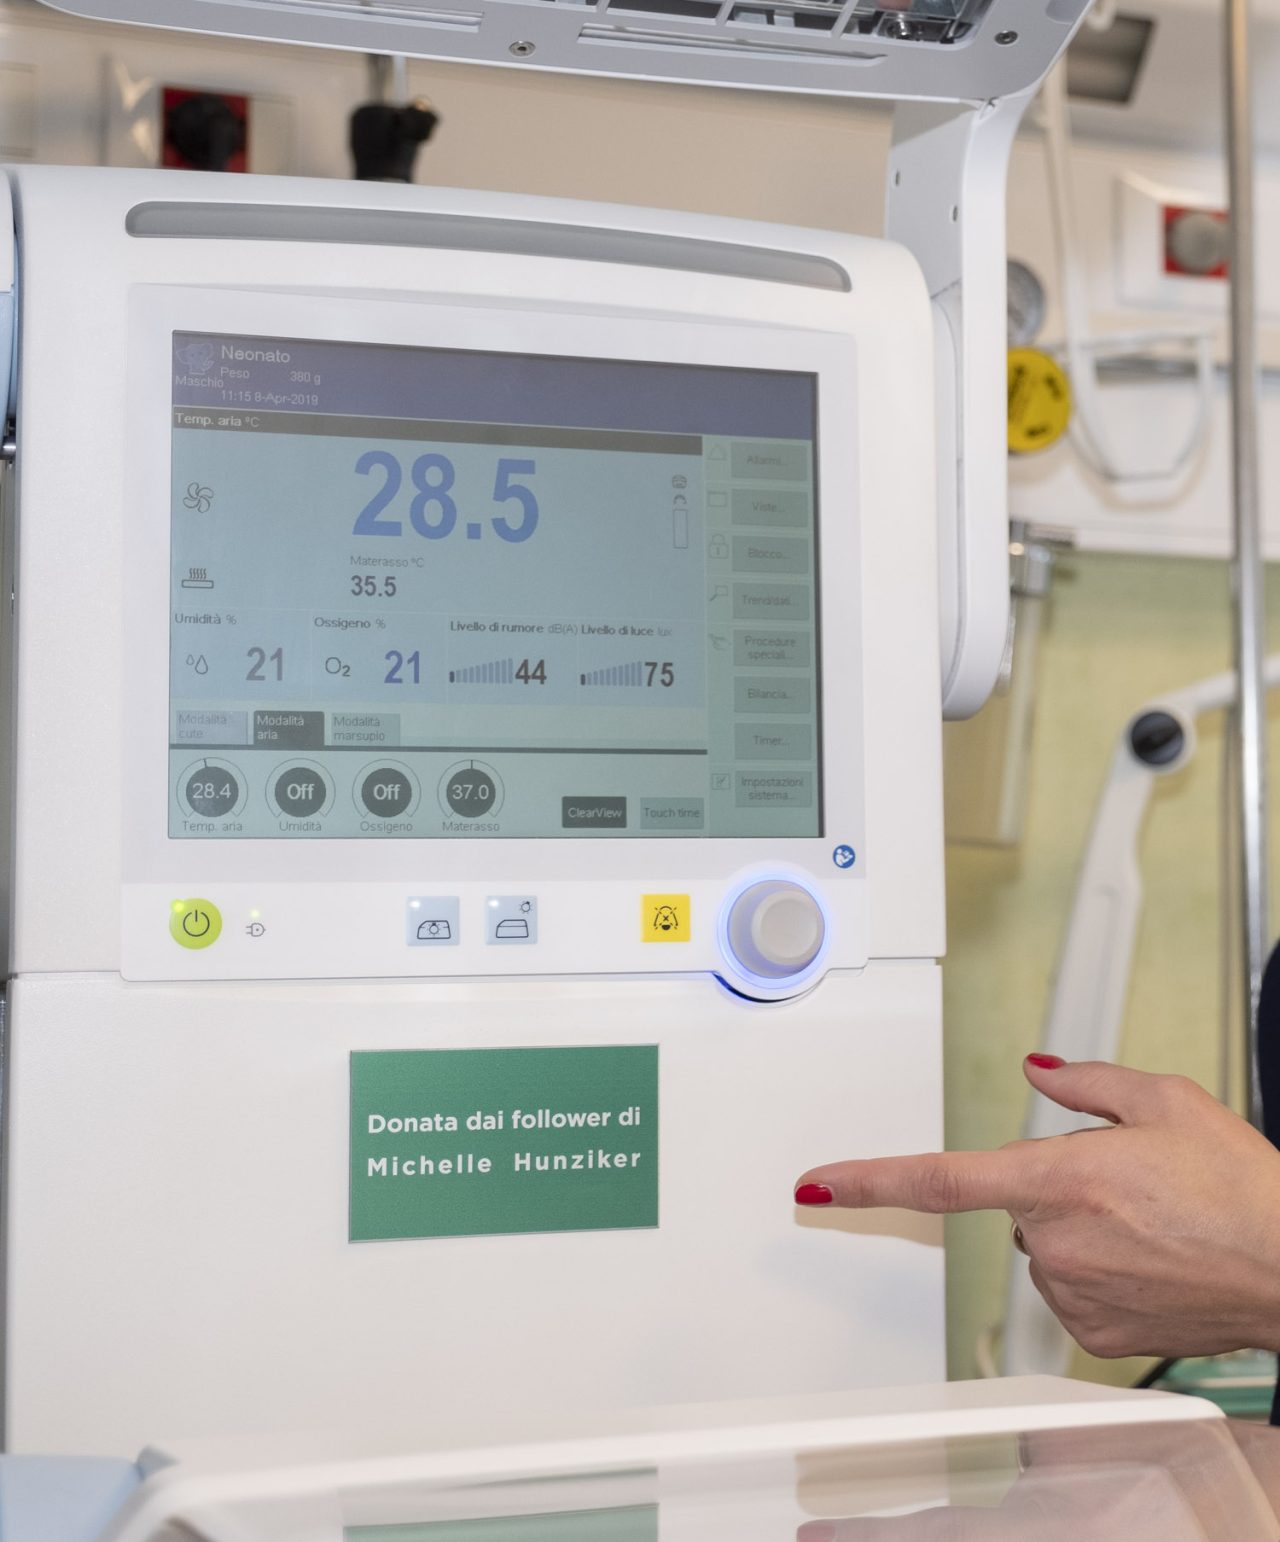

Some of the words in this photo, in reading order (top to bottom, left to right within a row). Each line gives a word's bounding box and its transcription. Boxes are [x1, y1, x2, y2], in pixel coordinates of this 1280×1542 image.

[221, 345, 290, 364] Neonato
[175, 376, 224, 389] Maschio
[220, 367, 250, 379] Peso
[313, 373, 321, 385] g
[221, 390, 251, 402] 11:15
[175, 412, 214, 426] Temp.
[218, 415, 241, 427] aria
[352, 451, 539, 543] 28.5
[350, 556, 408, 568] Materasso
[351, 575, 397, 598] 35.5
[175, 613, 221, 625] Umidità
[225, 615, 237, 625] %
[314, 617, 371, 631] Ossigeno
[375, 618, 386, 629] %
[450, 621, 486, 634] Livello
[489, 622, 499, 634] di
[501, 624, 544, 635] rumore
[547, 623, 579, 637] dB(A)
[581, 625, 615, 636] Livello
[618, 626, 628, 637] di
[631, 626, 654, 637] luce
[744, 636, 796, 646] Procedure
[246, 647, 283, 681] 21
[384, 650, 420, 684] 21
[514, 659, 547, 685] 44
[644, 662, 675, 687] 75
[257, 716, 305, 727] Modalità
[334, 716, 381, 727] Modalità
[257, 730, 278, 740] aria
[334, 731, 386, 743] marsupio
[741, 777, 804, 789] Impostazioni
[192, 783, 232, 799] 28.4
[287, 783, 315, 800] Off
[373, 784, 401, 800] Off
[452, 785, 490, 800] 37.0
[568, 807, 622, 819] ClearView
[644, 807, 674, 819] Touch
[677, 807, 700, 819] time
[182, 821, 217, 833] Temp.
[222, 822, 242, 832] aria
[279, 821, 322, 832] Umidità
[360, 822, 413, 834] Ossigeno
[442, 822, 500, 833] Materasso
[368, 1113, 458, 1133] Donata
[466, 1111, 504, 1131] dai
[512, 1108, 611, 1129] follower
[619, 1107, 641, 1126] di
[368, 1154, 492, 1176] Michelle
[514, 1150, 641, 1172] Hunziker
